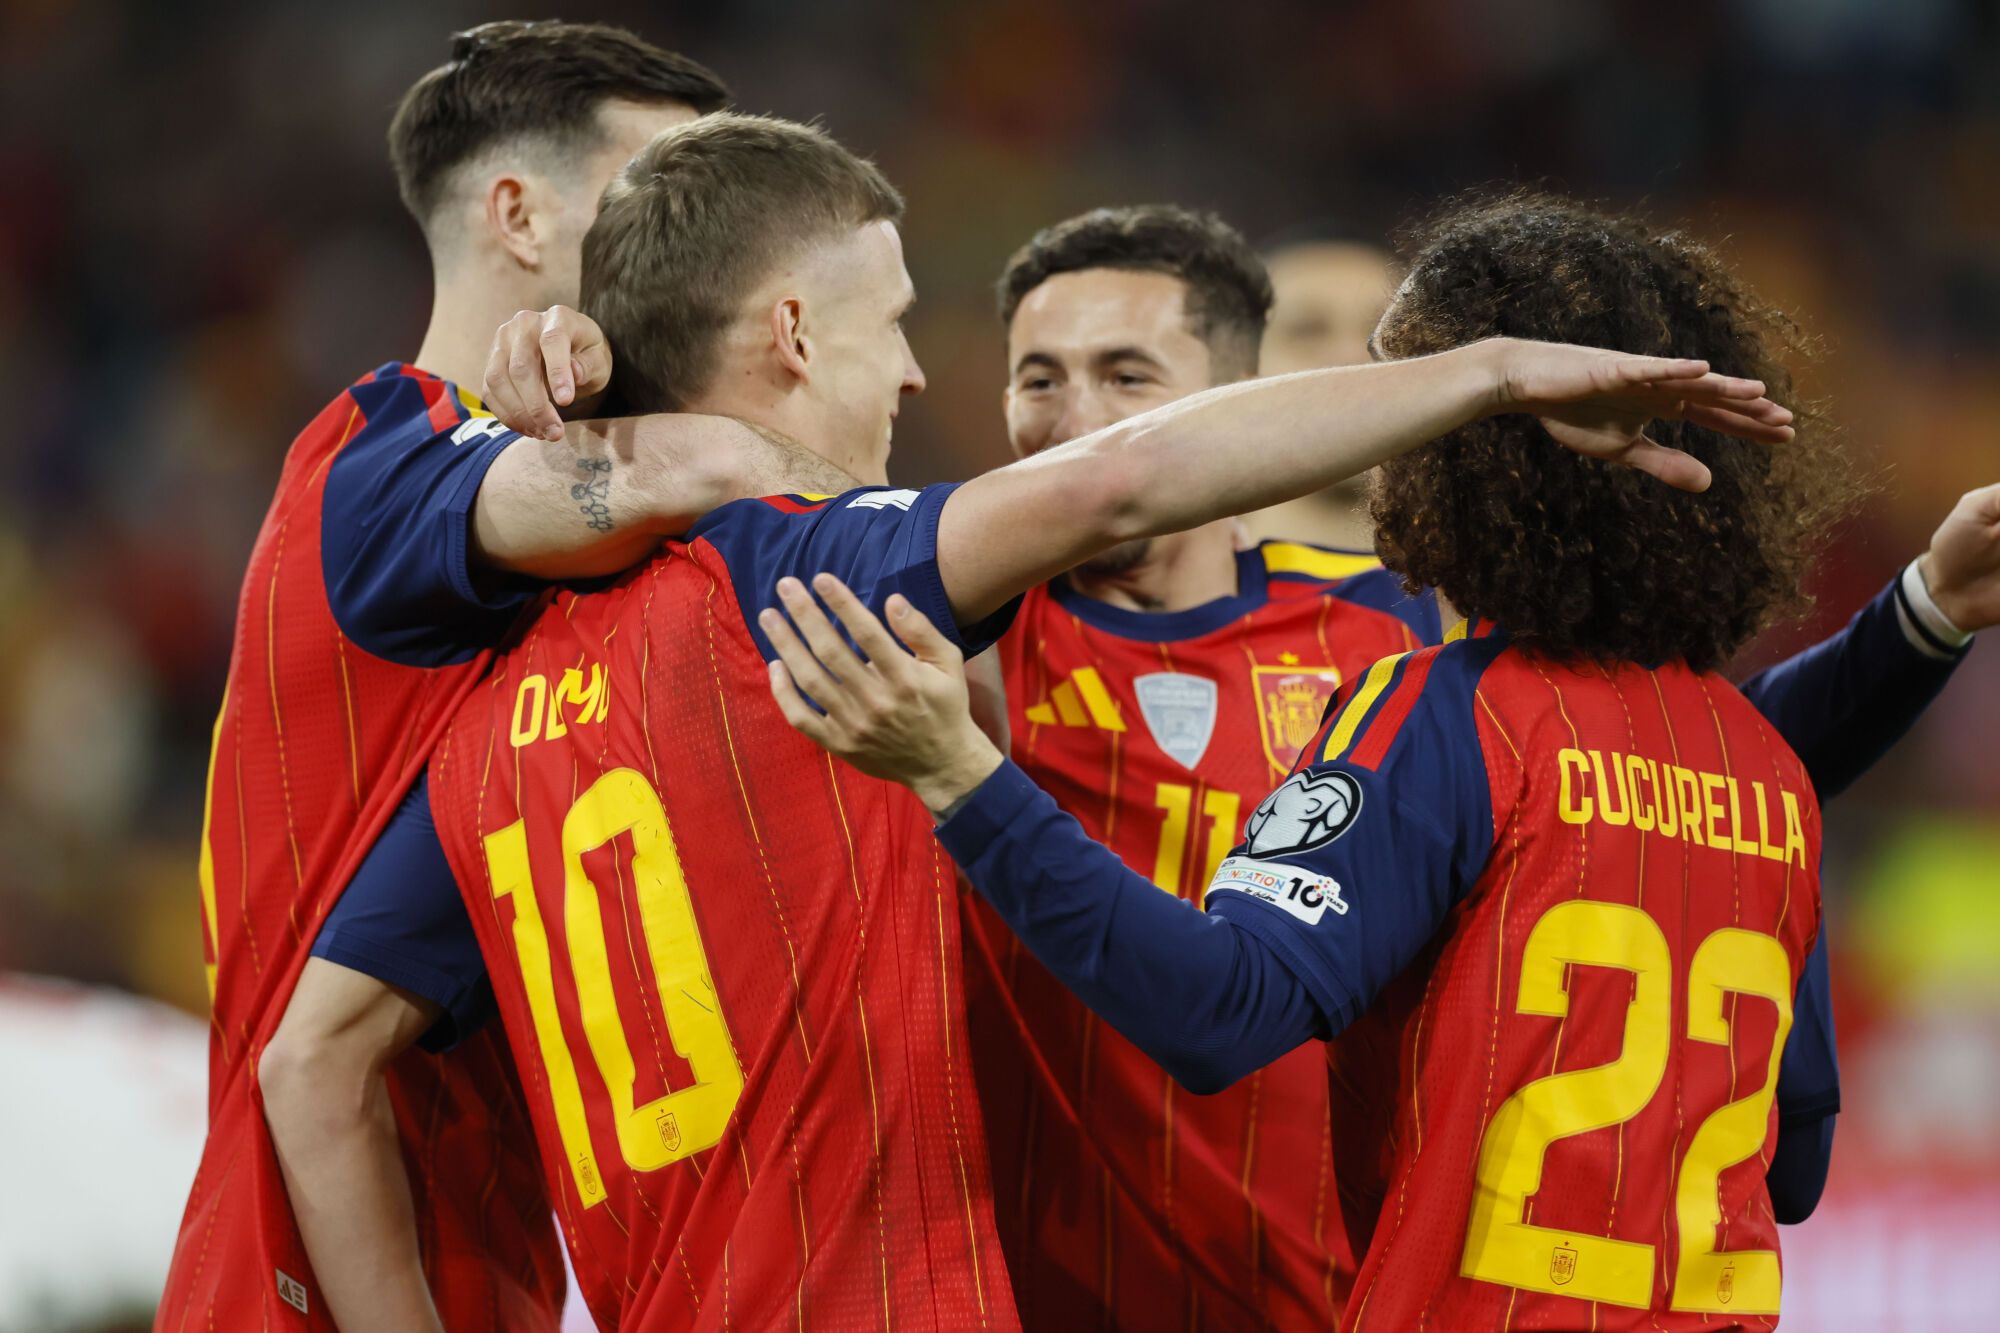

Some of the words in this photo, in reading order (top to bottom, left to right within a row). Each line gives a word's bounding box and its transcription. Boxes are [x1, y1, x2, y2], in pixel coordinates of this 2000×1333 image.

[1153, 782, 1240, 912] 11
[1557, 747, 1806, 870] CUCURELLA
[1287, 877, 1325, 909] 10
[483, 767, 745, 1210] 10
[1460, 899, 1794, 1316] 22
